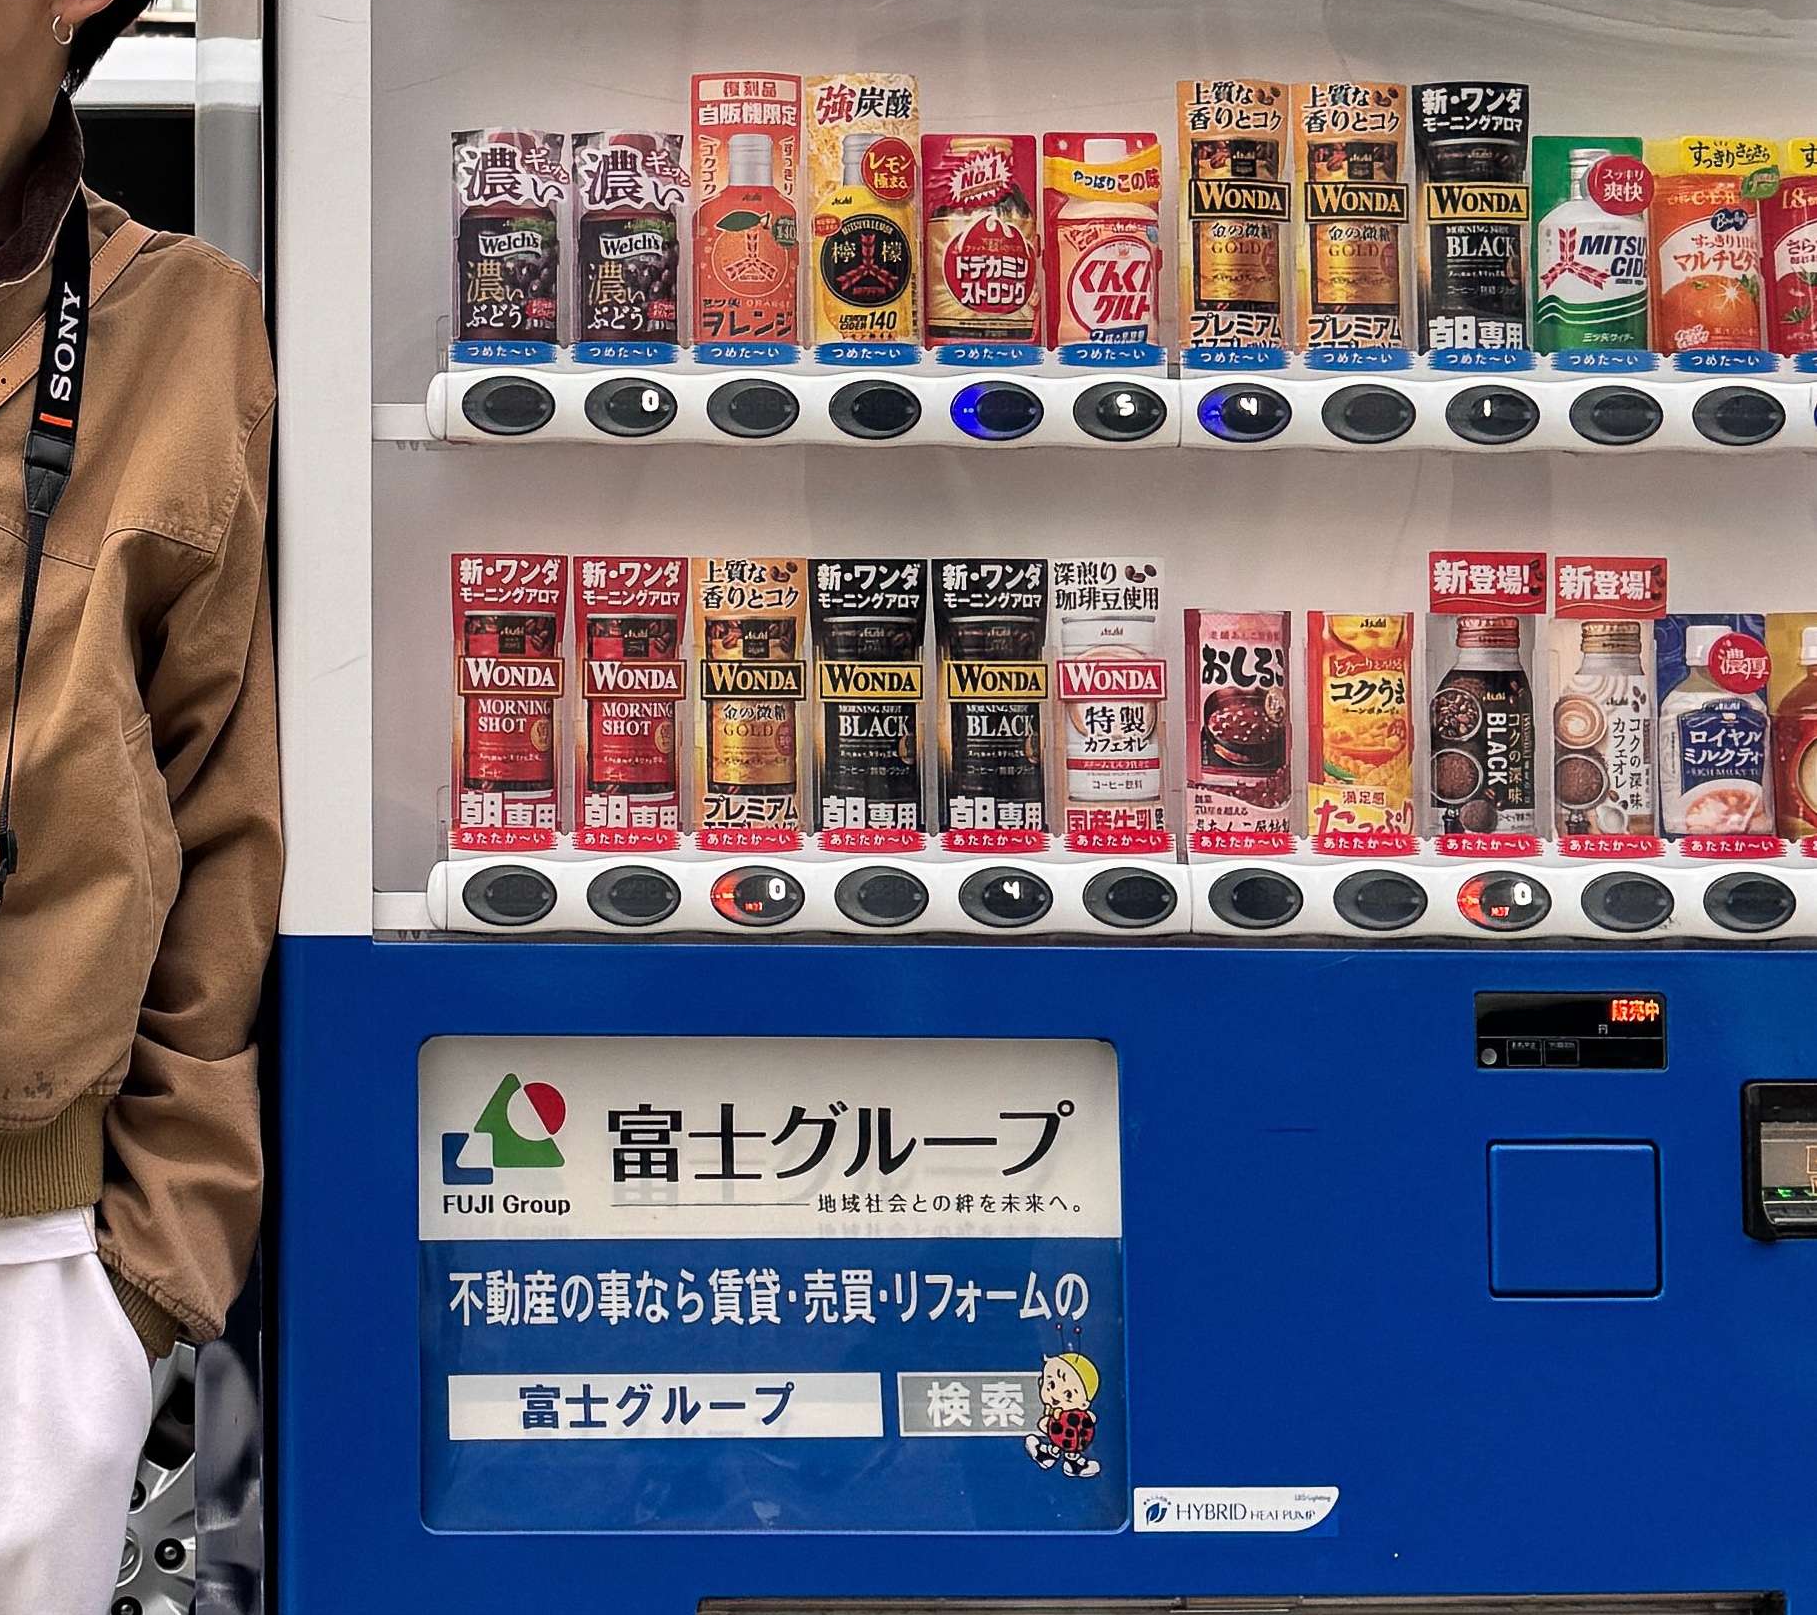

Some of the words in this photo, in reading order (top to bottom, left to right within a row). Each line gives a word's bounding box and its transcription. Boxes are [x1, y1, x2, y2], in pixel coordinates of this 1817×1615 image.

[815, 83, 913, 126] 強炭酸
[1187, 80, 1255, 105] 上質な
[1303, 84, 1371, 109] 上質な
[698, 103, 797, 127] 自販機限定
[1188, 106, 1283, 131] 香りとコク
[1304, 109, 1400, 134] 香りとコク
[1422, 115, 1523, 133] モーニングアロマ
[461, 146, 566, 203] 濃い
[868, 151, 912, 174] レモン
[582, 149, 686, 205] 濃い
[1197, 181, 1283, 212] WONDA
[1312, 184, 1401, 213] WONDA
[1434, 186, 1523, 214] WONDA
[1603, 183, 1644, 203] 爽快
[481, 235, 540, 256] Welch's
[603, 236, 661, 258] Welch's
[1211, 241, 1262, 255] GOLD
[1329, 243, 1379, 257] GOLD
[1447, 236, 1516, 258] BLACK
[955, 255, 1030, 280] ドデカミン
[466, 260, 524, 305] 濃い
[588, 261, 646, 306] 濃い
[960, 281, 1026, 306] ストロング
[466, 304, 524, 329] ぶどう
[587, 305, 646, 331] ぶどう
[867, 311, 897, 331] 140
[1189, 311, 1281, 337] プレミアム
[1308, 315, 1401, 340] プレミアム
[49, 281, 84, 403] SONY
[1429, 316, 1523, 350] 朝専用
[701, 559, 768, 585] 上質な
[1054, 561, 1118, 585] 深煎り
[460, 586, 560, 605] モーニングアロマ
[582, 588, 680, 607] モーニングアロマ
[702, 584, 798, 610] 香りとコク
[818, 591, 919, 609] モーニングアロマ
[943, 591, 1043, 609] モーニングアロマ
[1054, 587, 1159, 611] 珈琲豆使用
[709, 660, 798, 692] WONDA
[824, 663, 918, 693] WONDA
[1330, 678, 1406, 707] コクうま
[478, 717, 527, 734] SHOT
[602, 720, 651, 736] SHOT
[723, 722, 774, 738] GOLD
[838, 715, 910, 737] BLACK
[966, 715, 1035, 738] BLACK
[1085, 706, 1146, 733] 特製
[1084, 737, 1149, 753] カフェオレ
[1486, 712, 1508, 786] BLACK
[1689, 727, 1763, 748] ロイヤル
[1612, 717, 1628, 790] カフェオレ
[460, 792, 556, 829] 朝専用
[703, 795, 798, 822] プレミアム
[1342, 791, 1386, 806] 満足感
[584, 794, 678, 829] 朝専用
[822, 795, 918, 831] 朝専用
[949, 795, 1042, 831] 朝専用
[1611, 999, 1660, 1022] 販売中
[607, 1098, 1076, 1185] 富士グループ
[442, 1194, 495, 1215] FUJI
[502, 1193, 572, 1216] Group
[817, 1193, 1082, 1215] 地域社会との絆を未来へ。
[448, 1266, 1091, 1329] 不動産の事なら賃貸・売買・リフォームの
[518, 1380, 796, 1432] 富士グループ
[925, 1380, 1027, 1428] 検索
[1176, 1502, 1248, 1521] HYBRID
[1250, 1509, 1279, 1521] HEAT
[1282, 1509, 1317, 1521] PUMP
